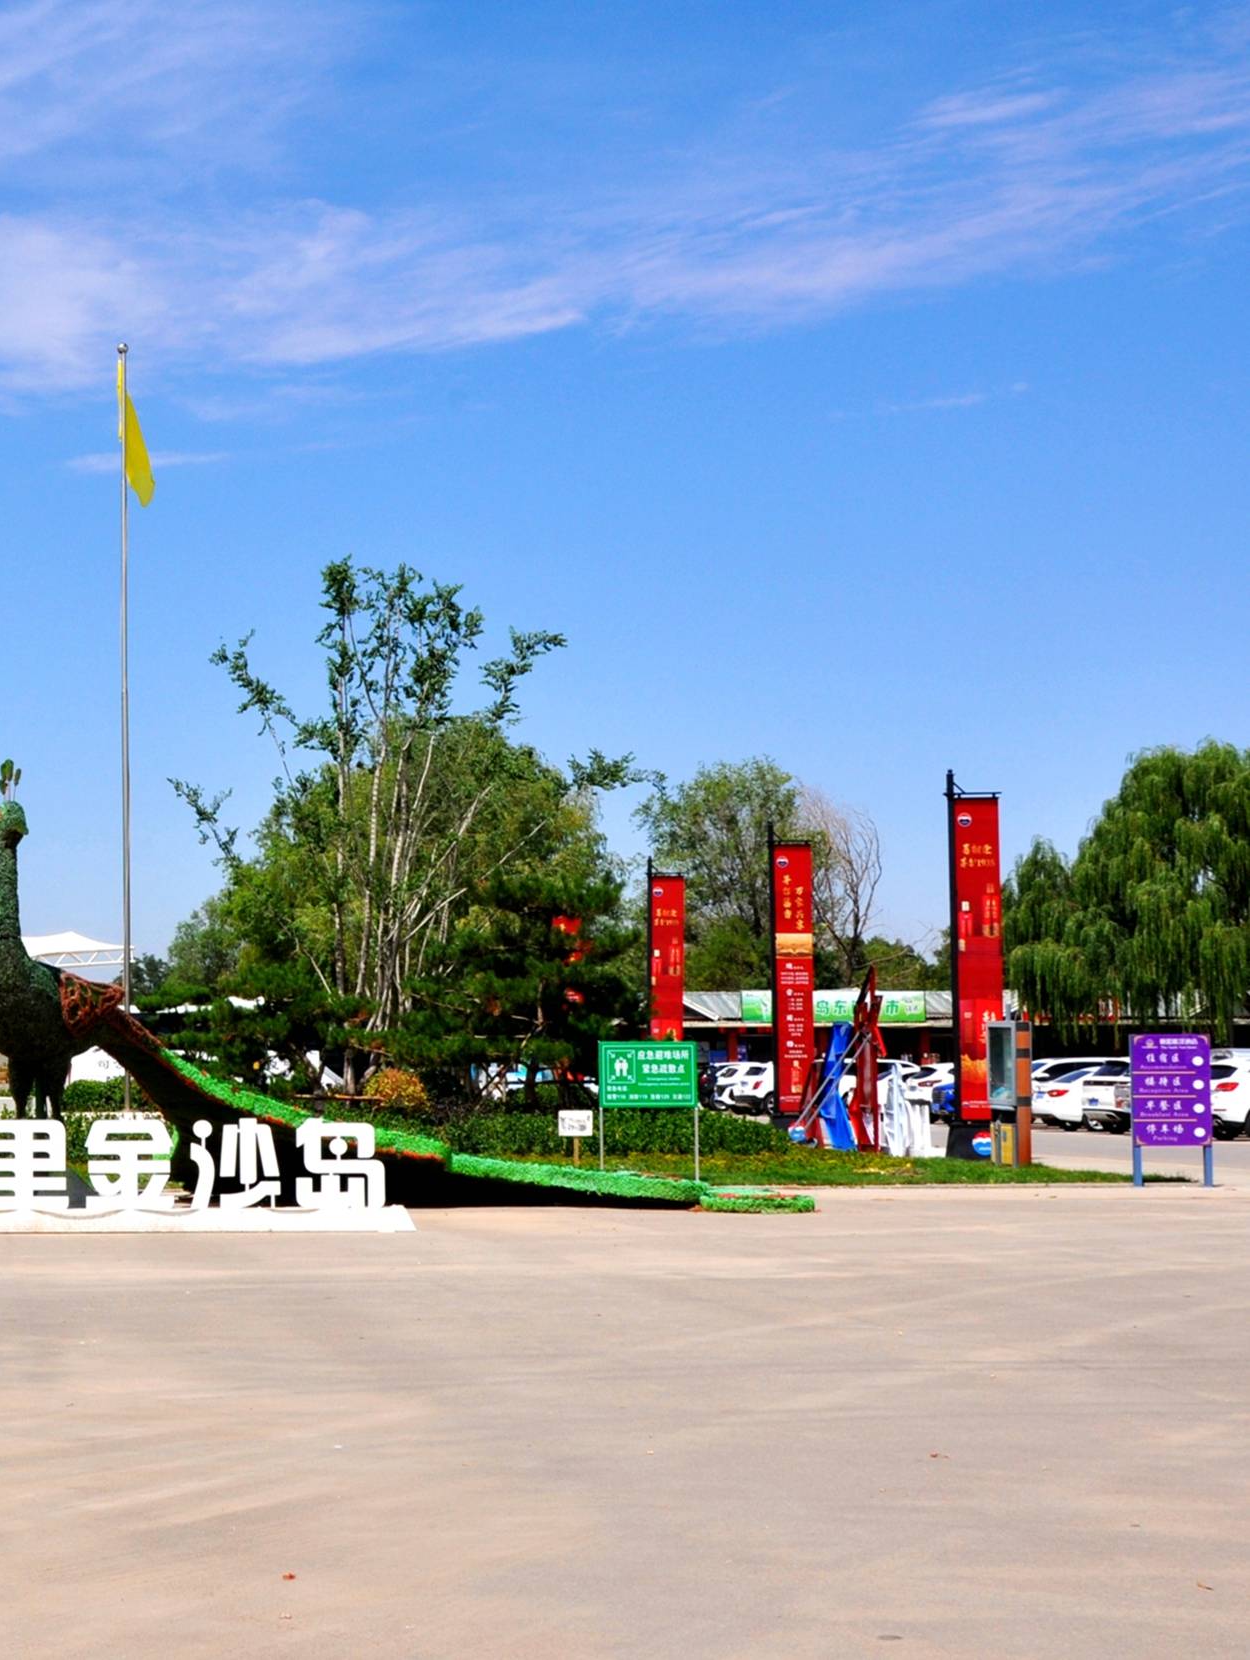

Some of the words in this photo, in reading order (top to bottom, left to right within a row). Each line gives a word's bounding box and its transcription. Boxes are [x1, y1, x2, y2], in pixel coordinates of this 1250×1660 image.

[816, 999, 899, 1016] 岛东市
[637, 1050, 689, 1060] 应急避难场所
[1146, 1053, 1179, 1063] 住宿区
[642, 1064, 685, 1074] 紧急疏散点
[1145, 1100, 1182, 1111] 早餐区
[1146, 1124, 1184, 1134] 停车场
